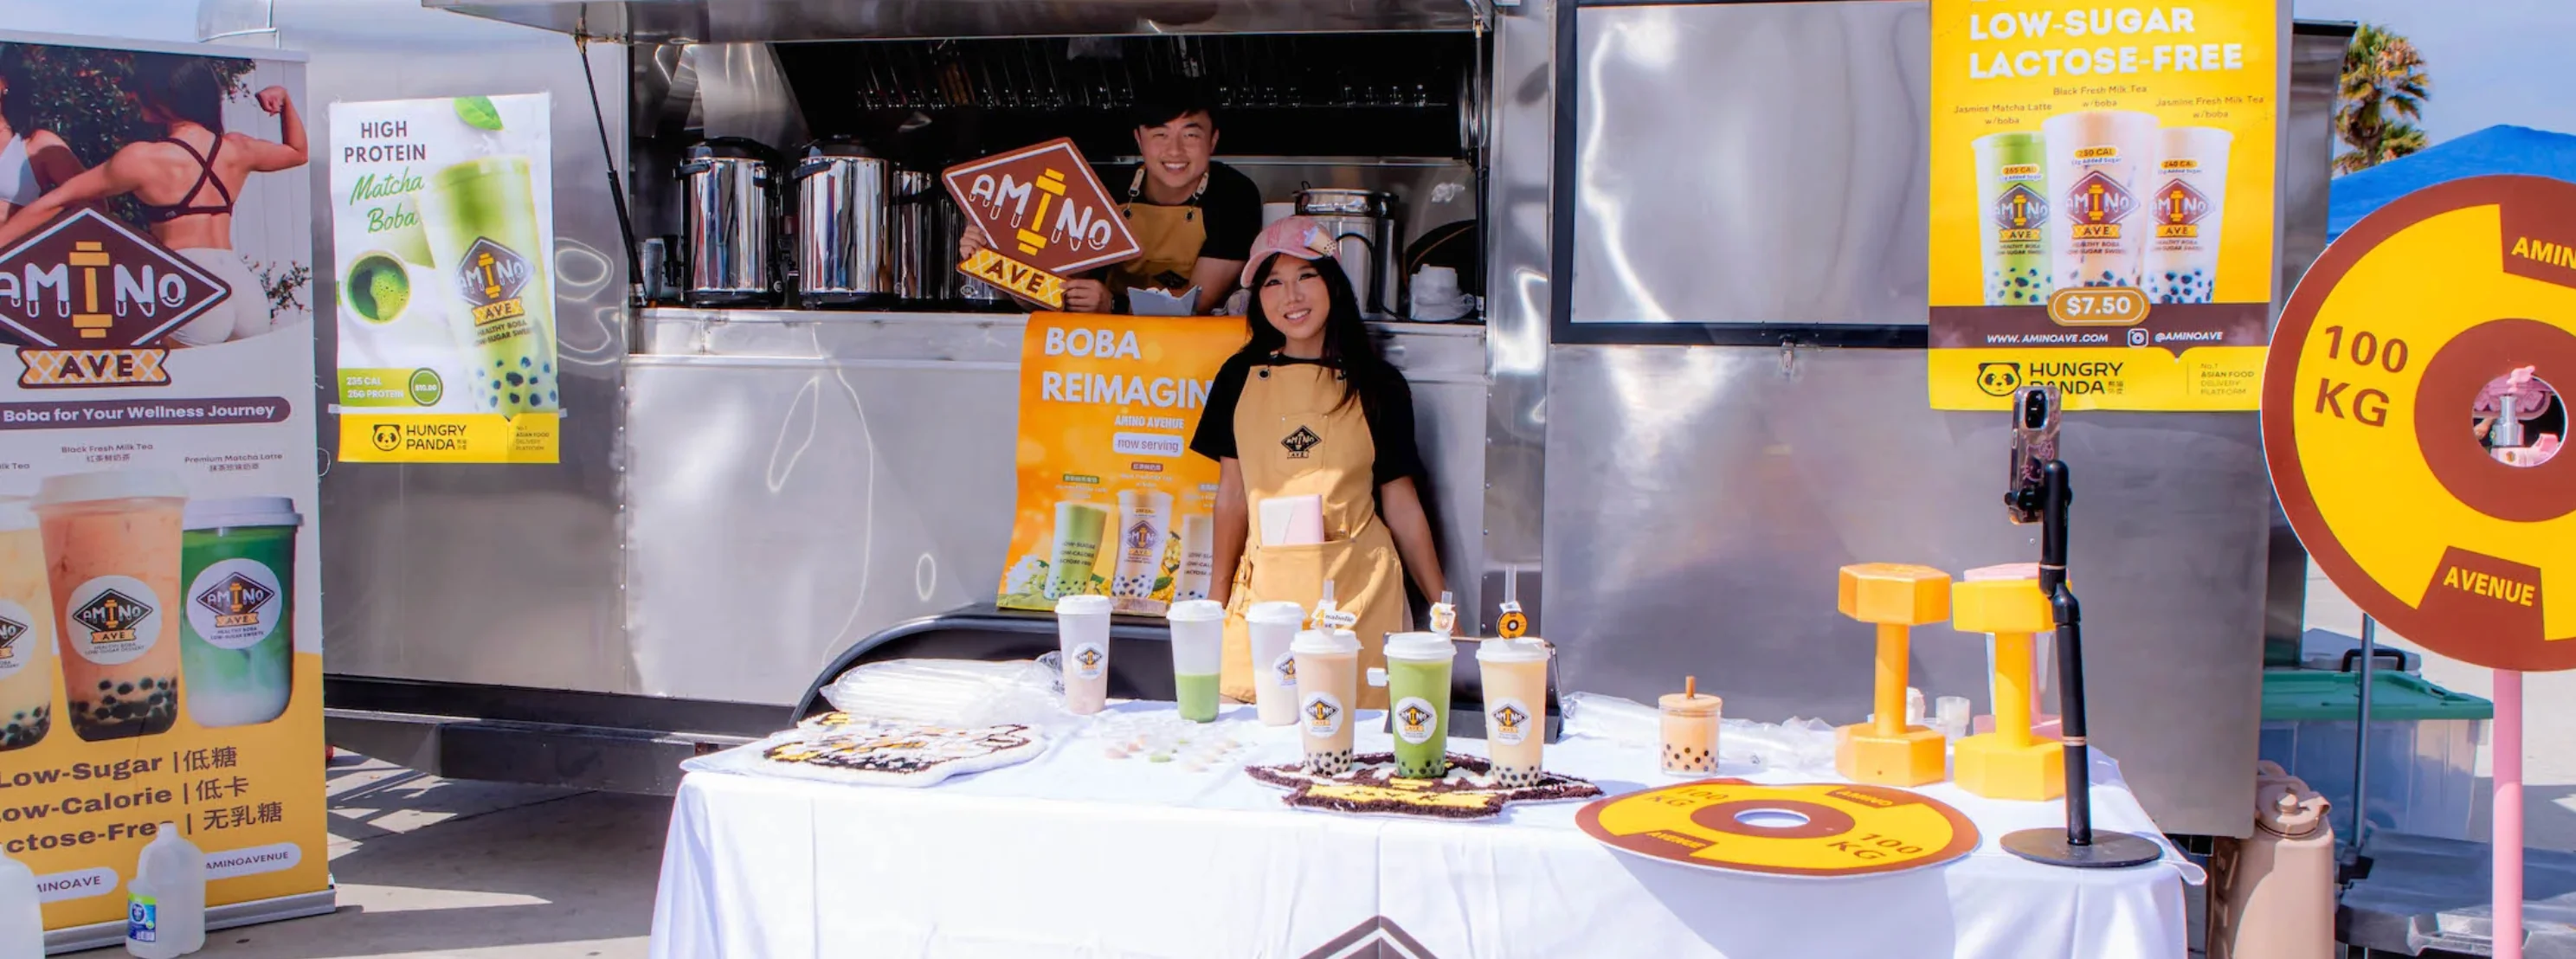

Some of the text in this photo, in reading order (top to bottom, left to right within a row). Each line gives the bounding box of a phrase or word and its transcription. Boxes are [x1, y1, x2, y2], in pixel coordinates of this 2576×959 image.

[1970, 7, 2194, 41] LOW-SUGAR
[1969, 43, 2243, 79] LACTOSE-FREE
[2081, 86, 2106, 94] Fresh
[2109, 85, 2126, 93] Milk
[1954, 105, 1989, 113] Jasmine
[2028, 103, 2052, 112] Latte
[2083, 99, 2117, 107] w/boba
[361, 120, 408, 138] HIGH
[345, 144, 427, 163] PROTEIN
[349, 166, 425, 206] Matcha
[367, 203, 419, 234] Boba
[968, 167, 1112, 257] AMINO
[2083, 226, 2110, 236] AVE
[2166, 227, 2188, 235] AVE
[2511, 235, 2576, 270] AMIN
[984, 259, 1046, 294] AVE
[485, 303, 512, 319] AVE
[2066, 297, 2131, 317] $7.50
[1044, 326, 1142, 360] BOBA
[2154, 331, 2224, 343] @AMINOAVE
[2325, 325, 2409, 374] 100
[58, 354, 134, 378] AVE
[2030, 362, 2124, 377] HUNGRY
[364, 377, 382, 386] CAL
[1041, 370, 1214, 409] REIMAGIN
[366, 389, 404, 398] PROTEIN
[2314, 377, 2391, 428] KG
[3, 404, 275, 422] Boba for Your Wellness Journey
[1114, 415, 1185, 429] AMINO AVENUE
[406, 424, 467, 436] HUNGRY
[406, 438, 455, 451] PANDA
[1117, 439, 1179, 453] now serving
[2442, 565, 2536, 608] AVENUE
[227, 615, 248, 624] AVE
[102, 631, 126, 640] AVE
[183, 744, 238, 774] 低糖
[0, 788, 172, 823] ow-Calorie
[196, 776, 249, 802] 低卡
[1644, 795, 1696, 807] KG
[1677, 788, 1729, 801] 100
[0, 820, 175, 854] ctose-Fre
[203, 801, 283, 831] 无乳糖
[1645, 832, 1708, 849] AVENUE
[1859, 833, 1923, 854] 100
[1826, 841, 1888, 859] KG
[37, 875, 101, 892] INOAVE
